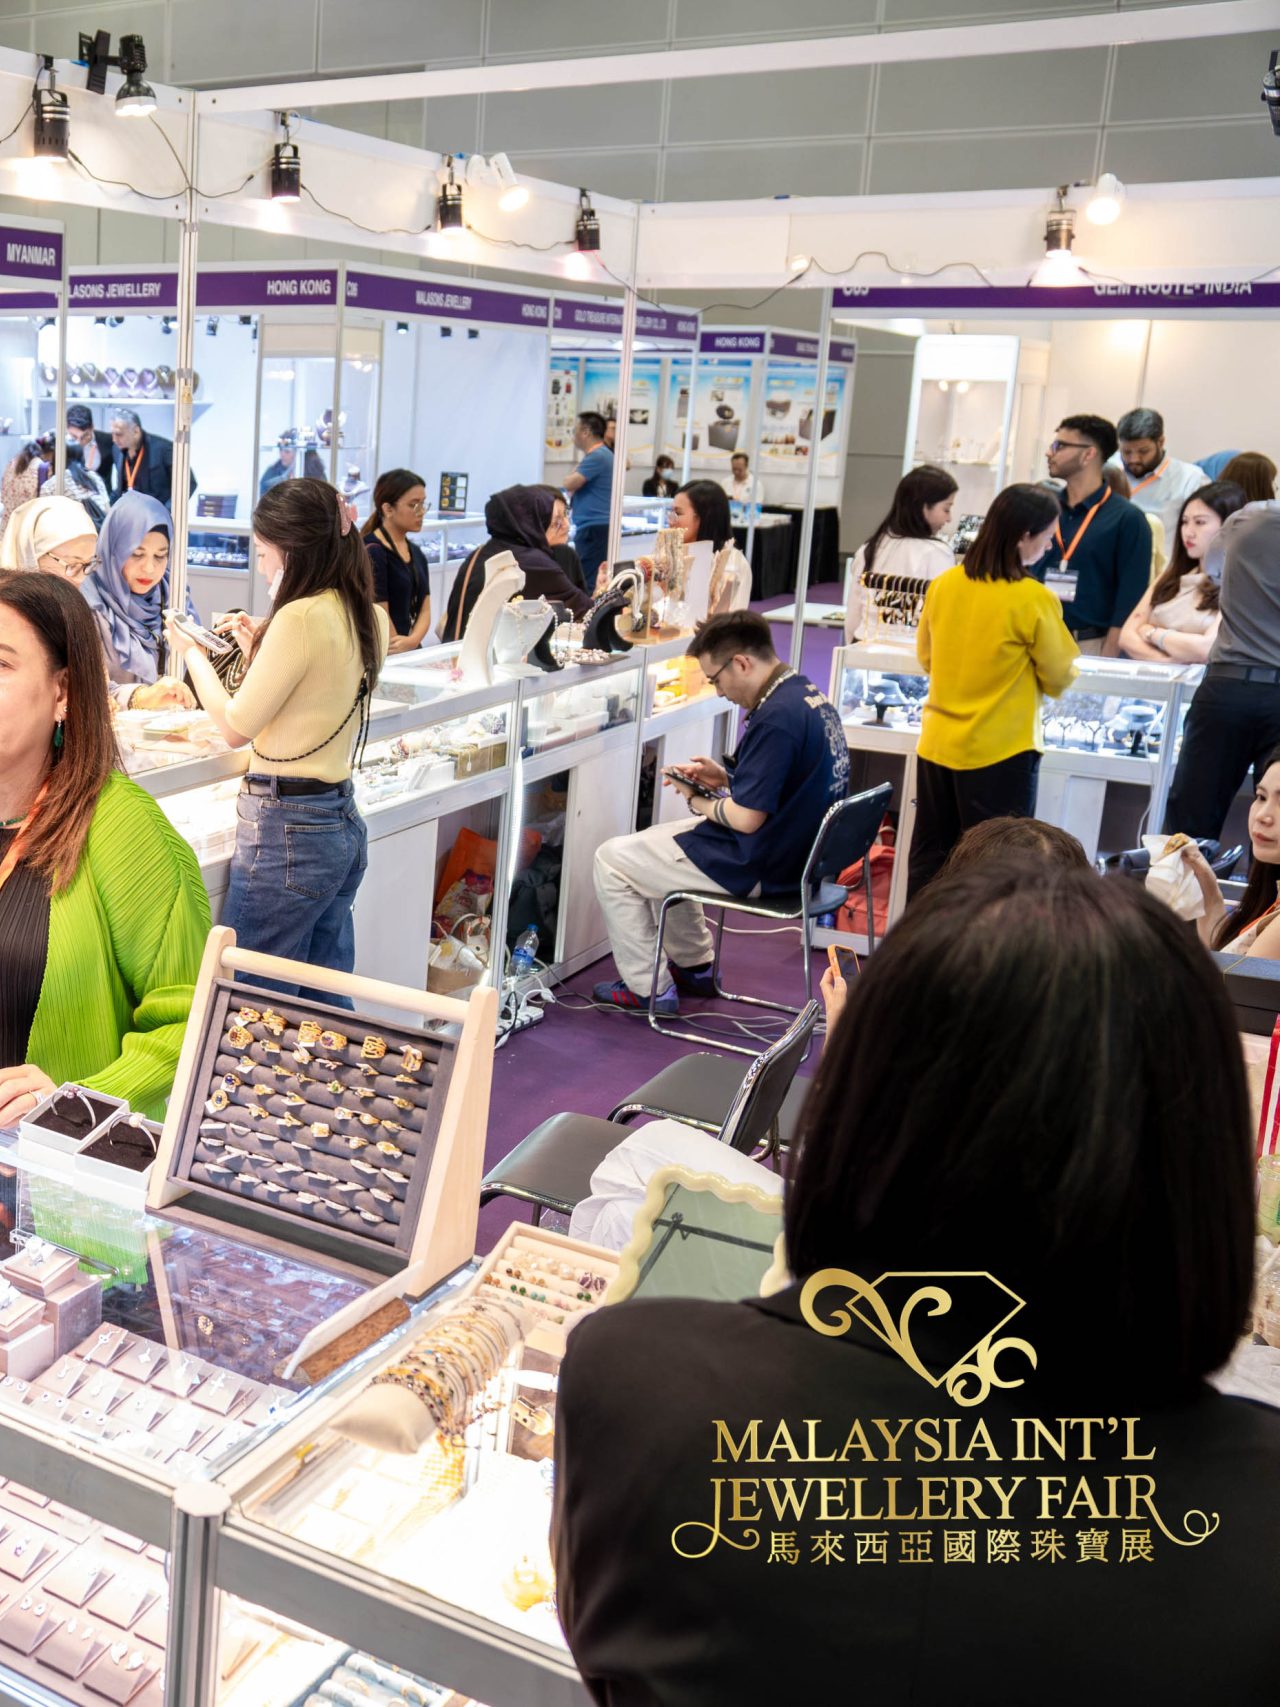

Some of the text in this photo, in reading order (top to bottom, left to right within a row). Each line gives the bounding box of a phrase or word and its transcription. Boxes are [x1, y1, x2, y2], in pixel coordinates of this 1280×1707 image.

[6, 242, 56, 267] MYANMAR
[67, 282, 161, 298] LASONS JEWELLERY
[266, 279, 331, 296] HONG KONG
[714, 336, 737, 347] HONG
[738, 336, 761, 348] KONG
